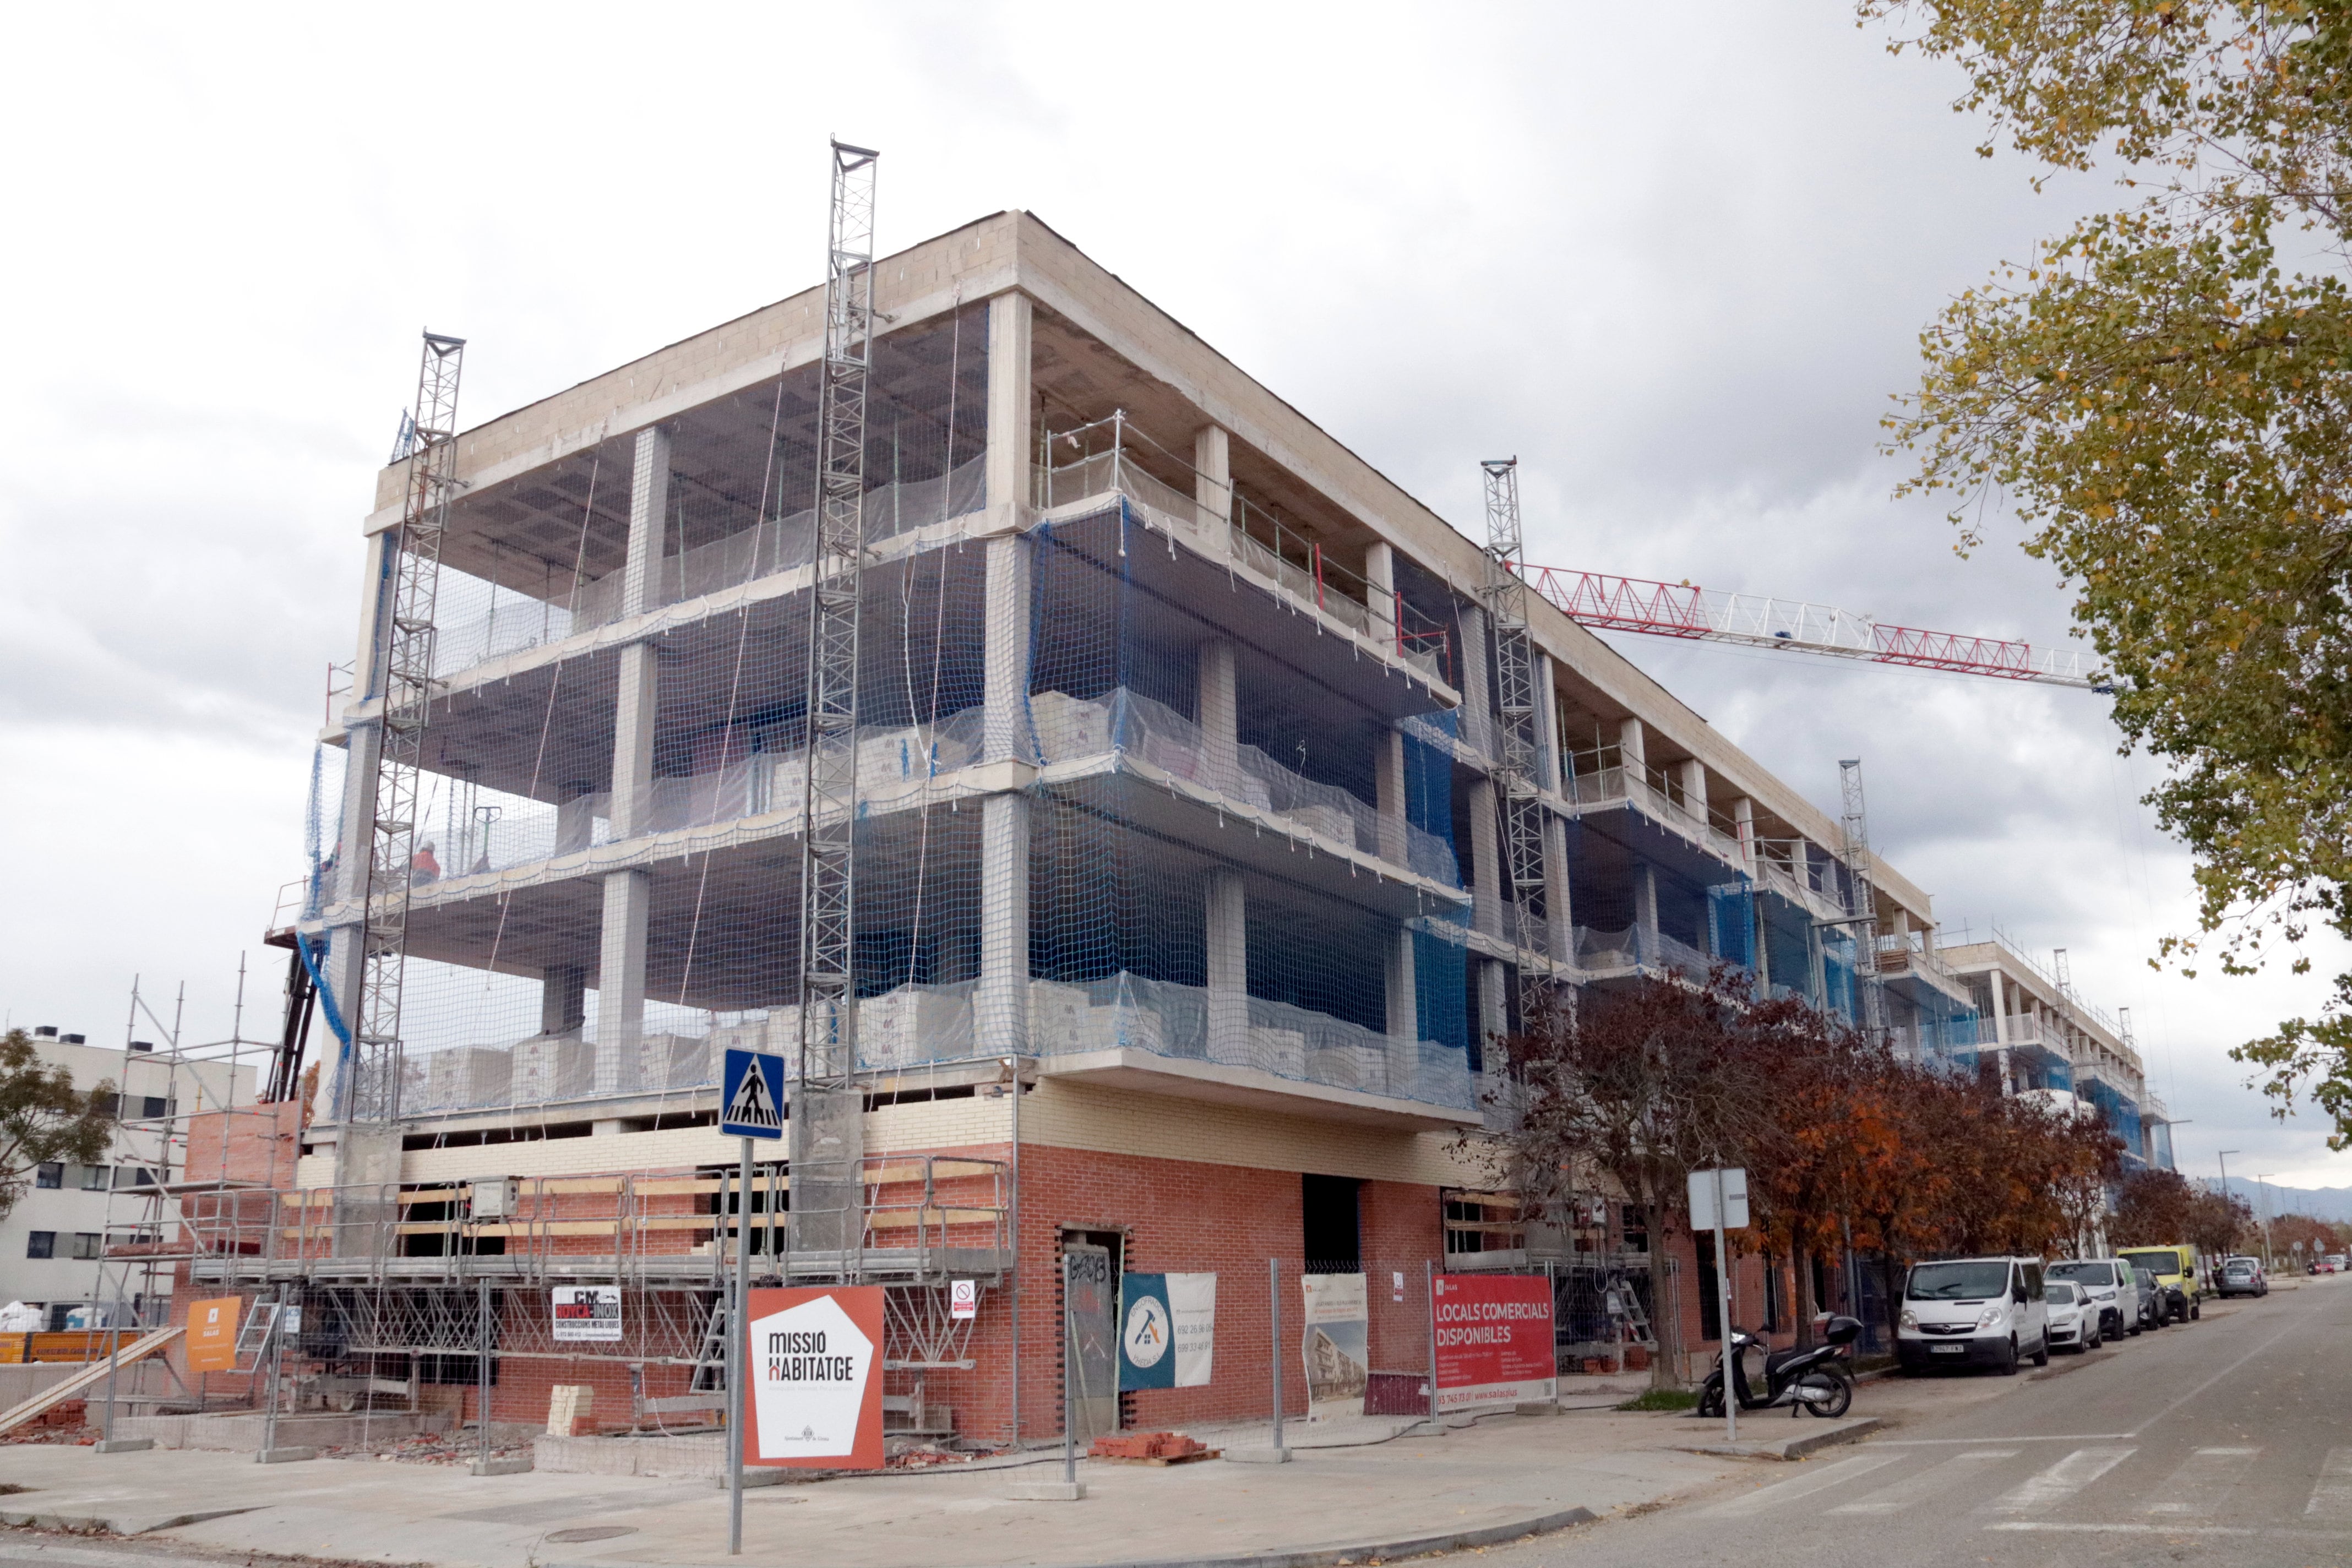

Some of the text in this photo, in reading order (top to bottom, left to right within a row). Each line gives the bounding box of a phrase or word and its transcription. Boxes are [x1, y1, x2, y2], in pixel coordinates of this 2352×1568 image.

[1130, 1297, 1164, 1317] ENCOFRADOS
[1436, 1303, 1549, 1322] LOCALS COMERCIALS
[556, 1320, 591, 1329] CONSTRUCCIONS
[1178, 1325, 1189, 1335] 692
[1190, 1325, 1197, 1334] 26
[1437, 1326, 1511, 1347] DISPONIBLES
[1178, 1343, 1189, 1353] 699
[1189, 1342, 1197, 1352] 33
[1133, 1354, 1151, 1366] YHEDA
[769, 1357, 853, 1381] HABITATGE
[1438, 1395, 1445, 1404] 93
[1446, 1394, 1457, 1403] 745
